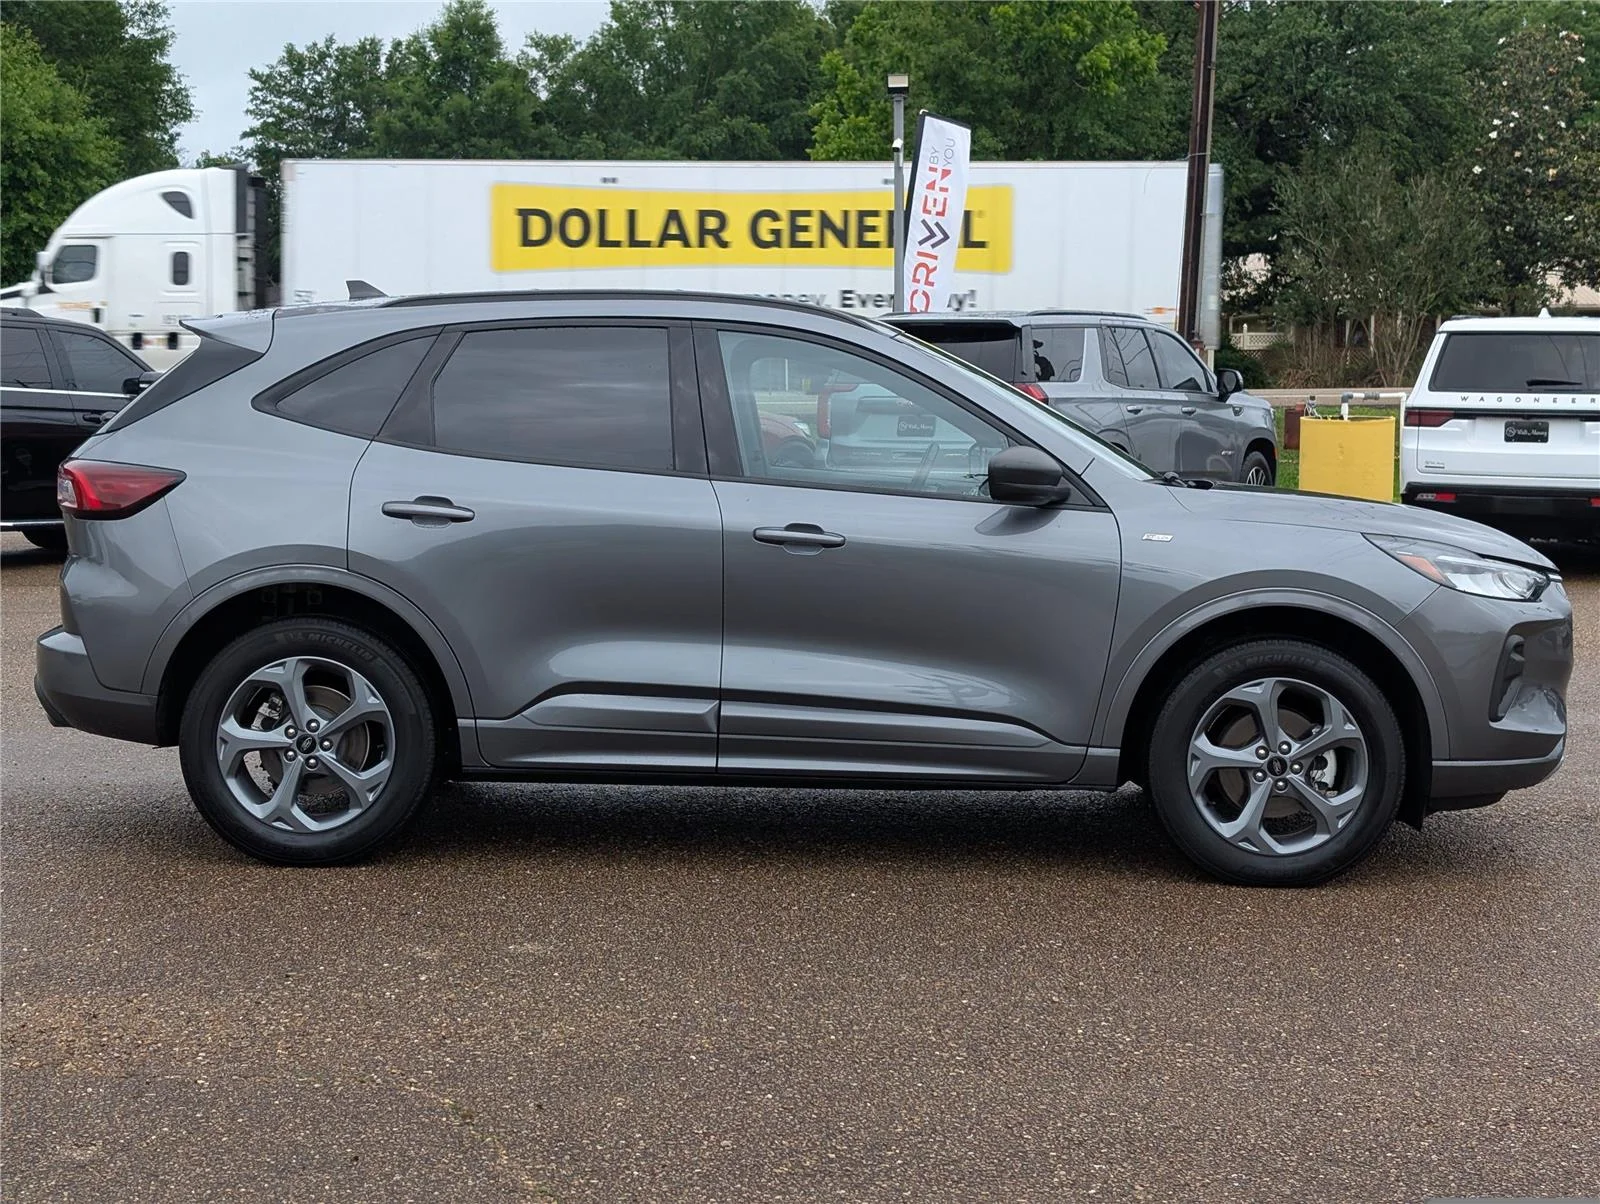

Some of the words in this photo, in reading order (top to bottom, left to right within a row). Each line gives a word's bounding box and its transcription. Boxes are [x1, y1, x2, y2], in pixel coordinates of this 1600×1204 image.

[929, 146, 941, 166] BY
[943, 138, 956, 168] YOU
[515, 207, 733, 249] DOLLAR
[749, 208, 988, 250] GENEL
[1460, 395, 1597, 405] WAGONEER
